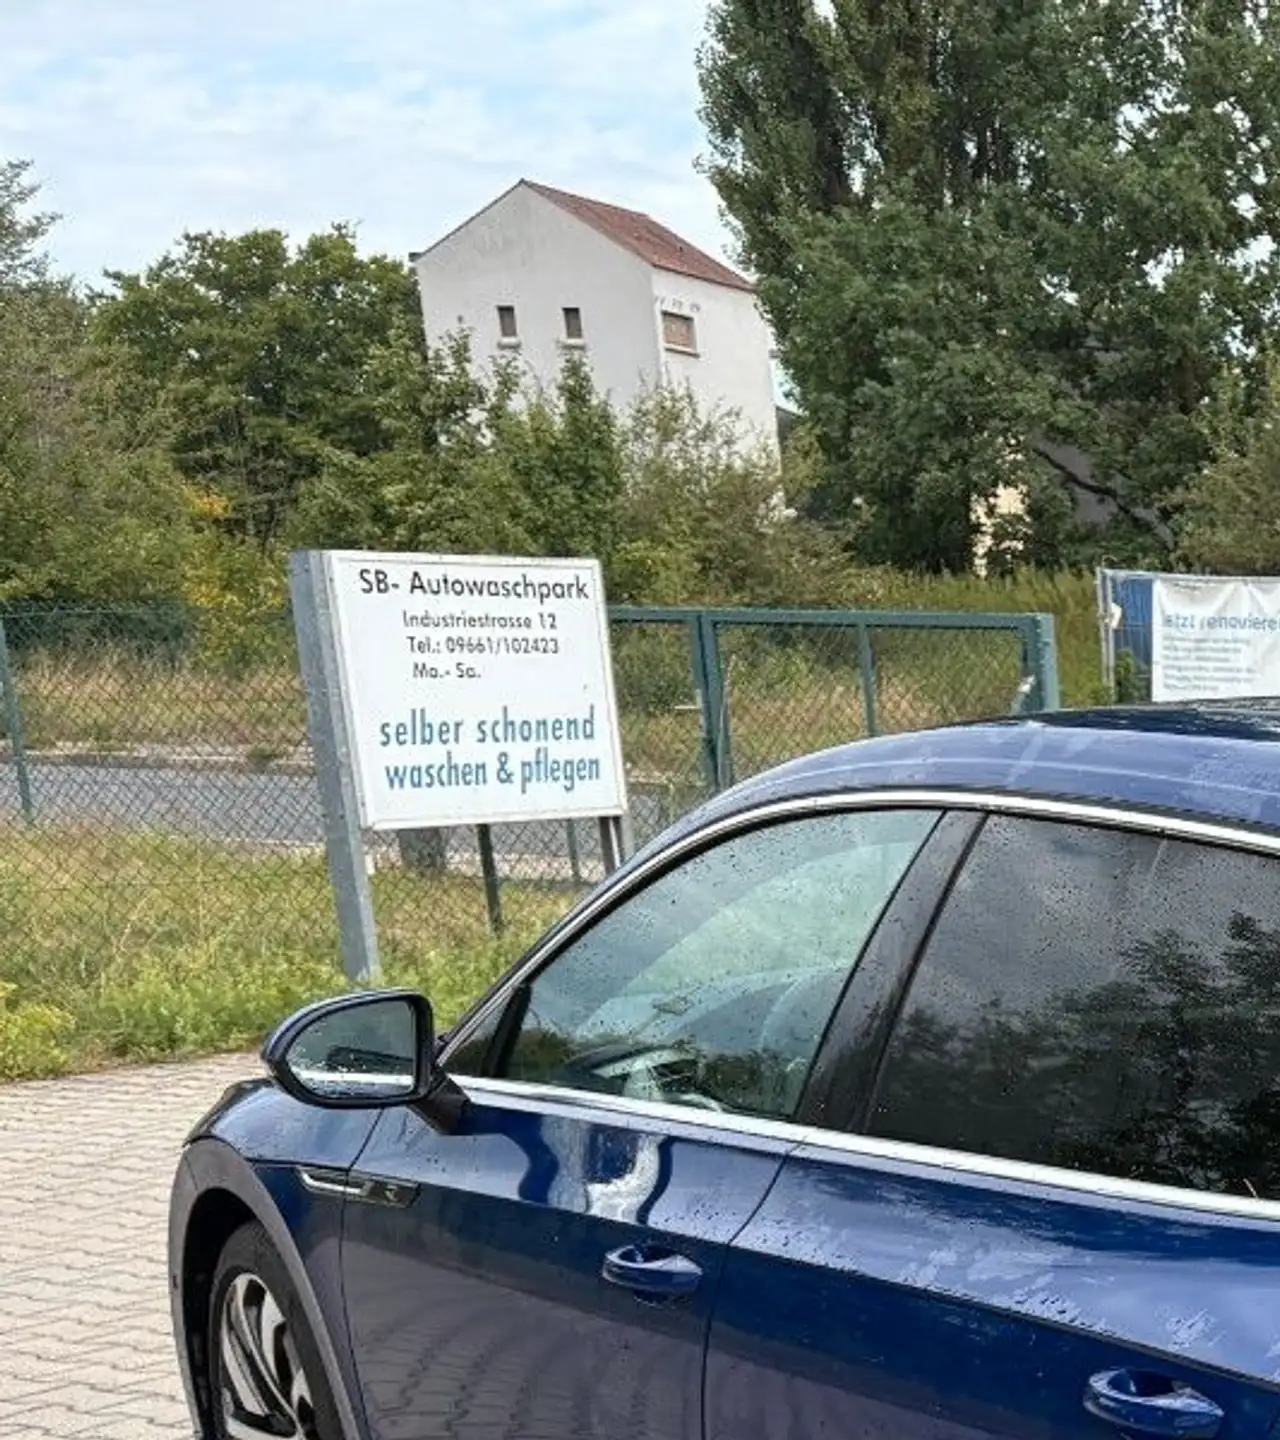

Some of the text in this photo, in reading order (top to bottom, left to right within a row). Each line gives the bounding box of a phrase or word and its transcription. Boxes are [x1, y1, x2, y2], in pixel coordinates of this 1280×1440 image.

[359, 569, 590, 603] SB- Autowaschpark
[403, 610, 557, 629] Industriestrasse 12
[406, 635, 559, 655] Tel.: 09661/102423
[455, 661, 482, 679] Sa.
[379, 705, 595, 747] selber schonend
[385, 748, 601, 795] waschen & pflegen
